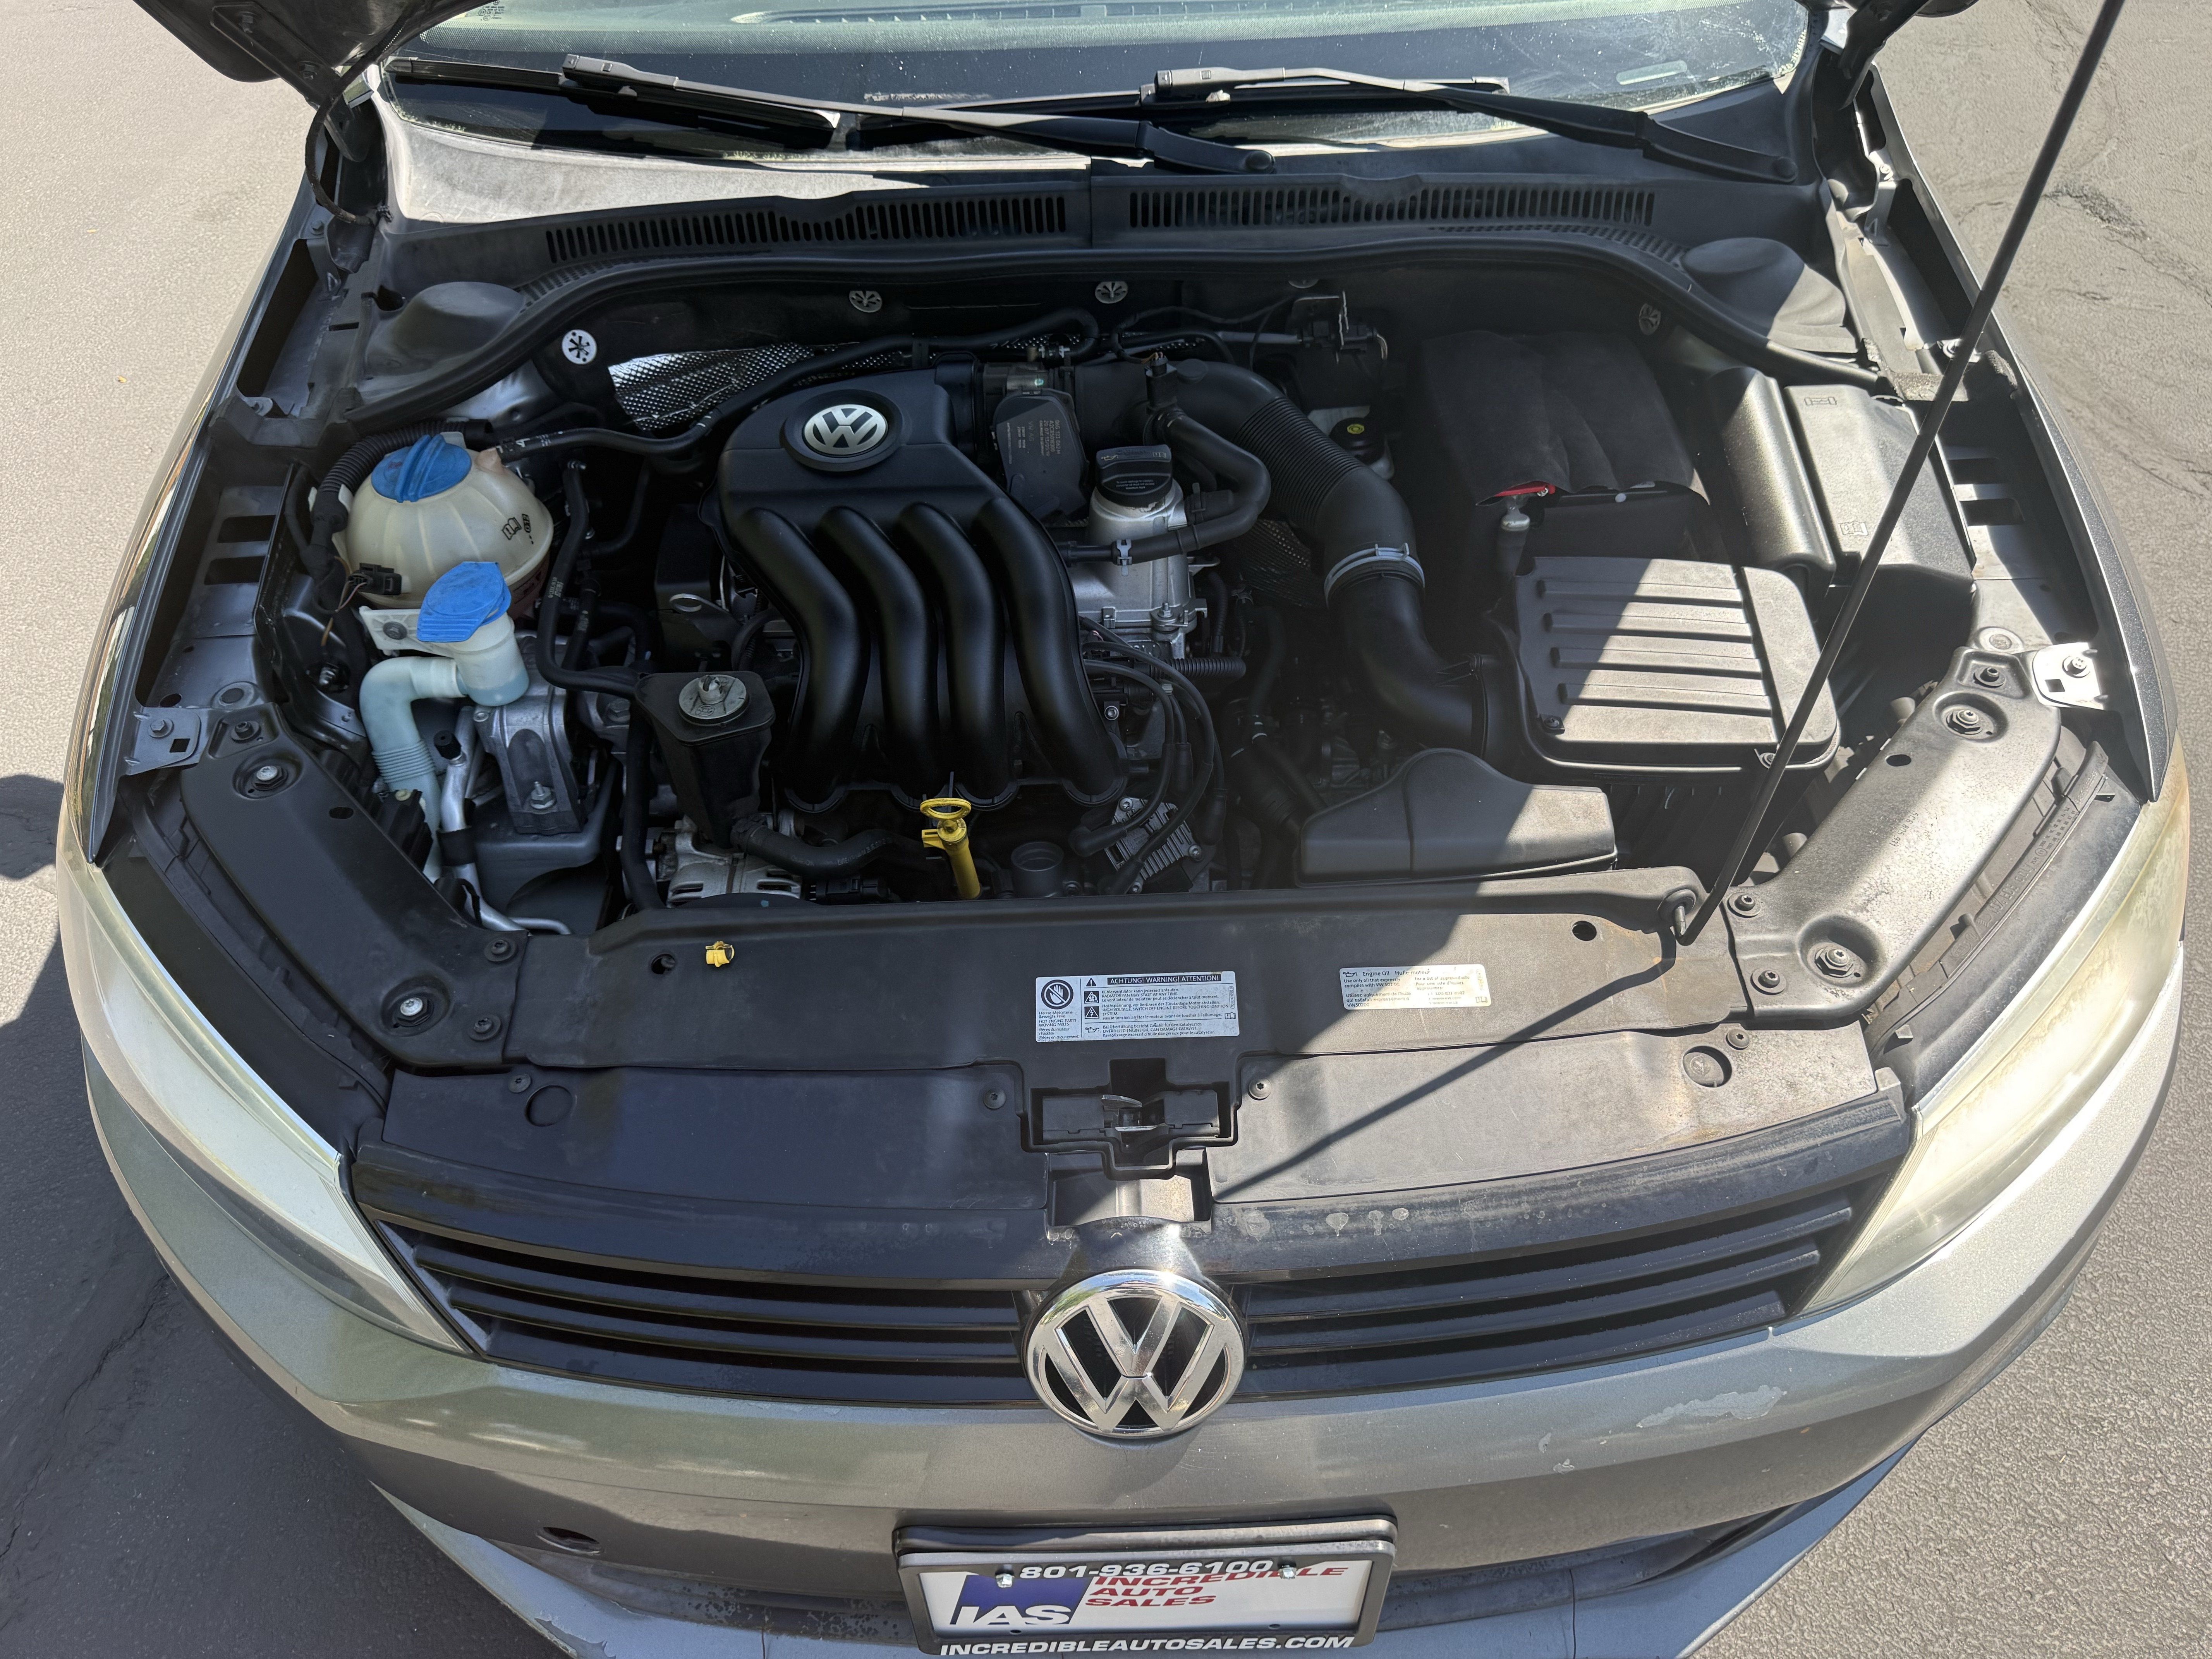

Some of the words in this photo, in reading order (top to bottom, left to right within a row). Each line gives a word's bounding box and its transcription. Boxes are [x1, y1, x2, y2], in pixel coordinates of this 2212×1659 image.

[1906, 811, 1918, 824] 5C6
[1898, 824, 1909, 835] 805
[1889, 836, 1901, 847] 931
[1020, 1560, 1274, 1579] 801-936-6100
[1089, 1587, 1204, 1597] AUTO
[1085, 1595, 1216, 1607] SALES
[955, 1605, 1073, 1625] IAS
[940, 1637, 1355, 1656] INCREDIBLEAUTOSALES.COM
